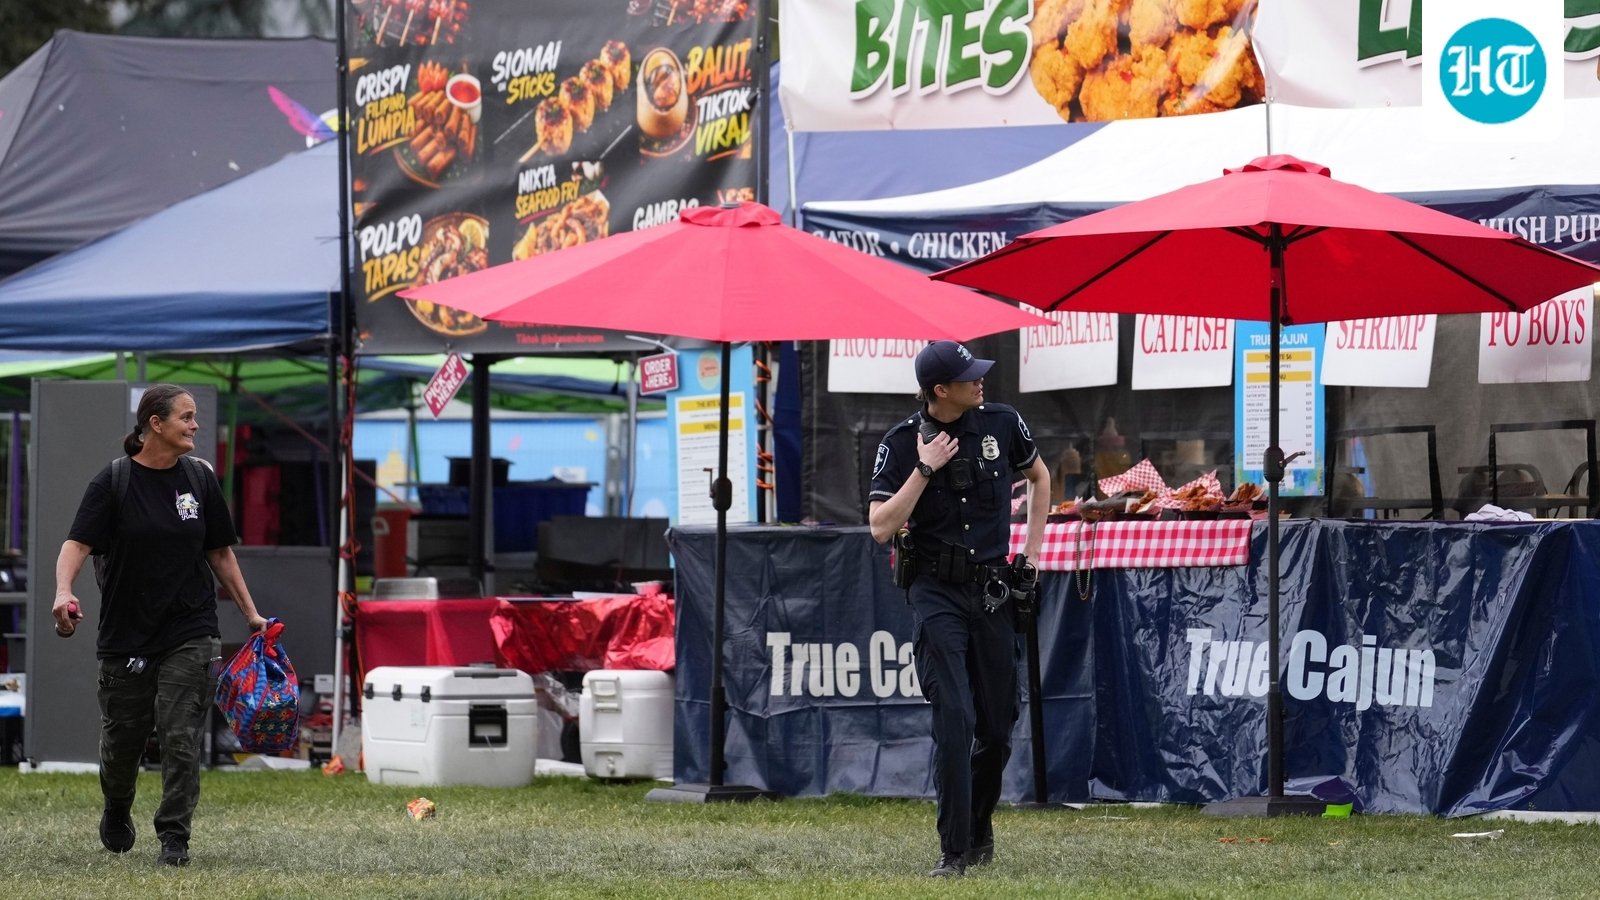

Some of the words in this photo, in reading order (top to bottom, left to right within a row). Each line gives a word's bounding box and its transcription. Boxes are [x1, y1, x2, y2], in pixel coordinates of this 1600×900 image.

[491, 40, 562, 84] SIOMAI
[851, 0, 1031, 96] BITES
[355, 63, 411, 107] CRISPY
[506, 72, 556, 106] STICKS
[696, 86, 752, 124] TIKTOK
[365, 93, 407, 120] FILIPINO
[357, 105, 416, 155] LUMPIA
[695, 112, 751, 156] VIRAL
[515, 187, 562, 218] SEAFOOD
[560, 181, 581, 204] FRY
[518, 164, 557, 195] MIXTA
[360, 213, 422, 262] POLPO
[908, 231, 1006, 259] CHICKEN
[363, 246, 421, 294] TAPAS
[1140, 313, 1238, 354] CATFISH
[1250, 333, 1271, 346] TRU
[1336, 314, 1426, 351] SHRIMP
[1488, 312, 1521, 347] PO
[1527, 298, 1585, 346] BOYS
[425, 354, 459, 405] PICK-UP
[644, 358, 671, 376] ORDER
[648, 372, 670, 388] HERE
[437, 374, 460, 406] HERE
[766, 632, 861, 698] True
[1187, 628, 1270, 698] True
[1287, 629, 1436, 711] Cajun
